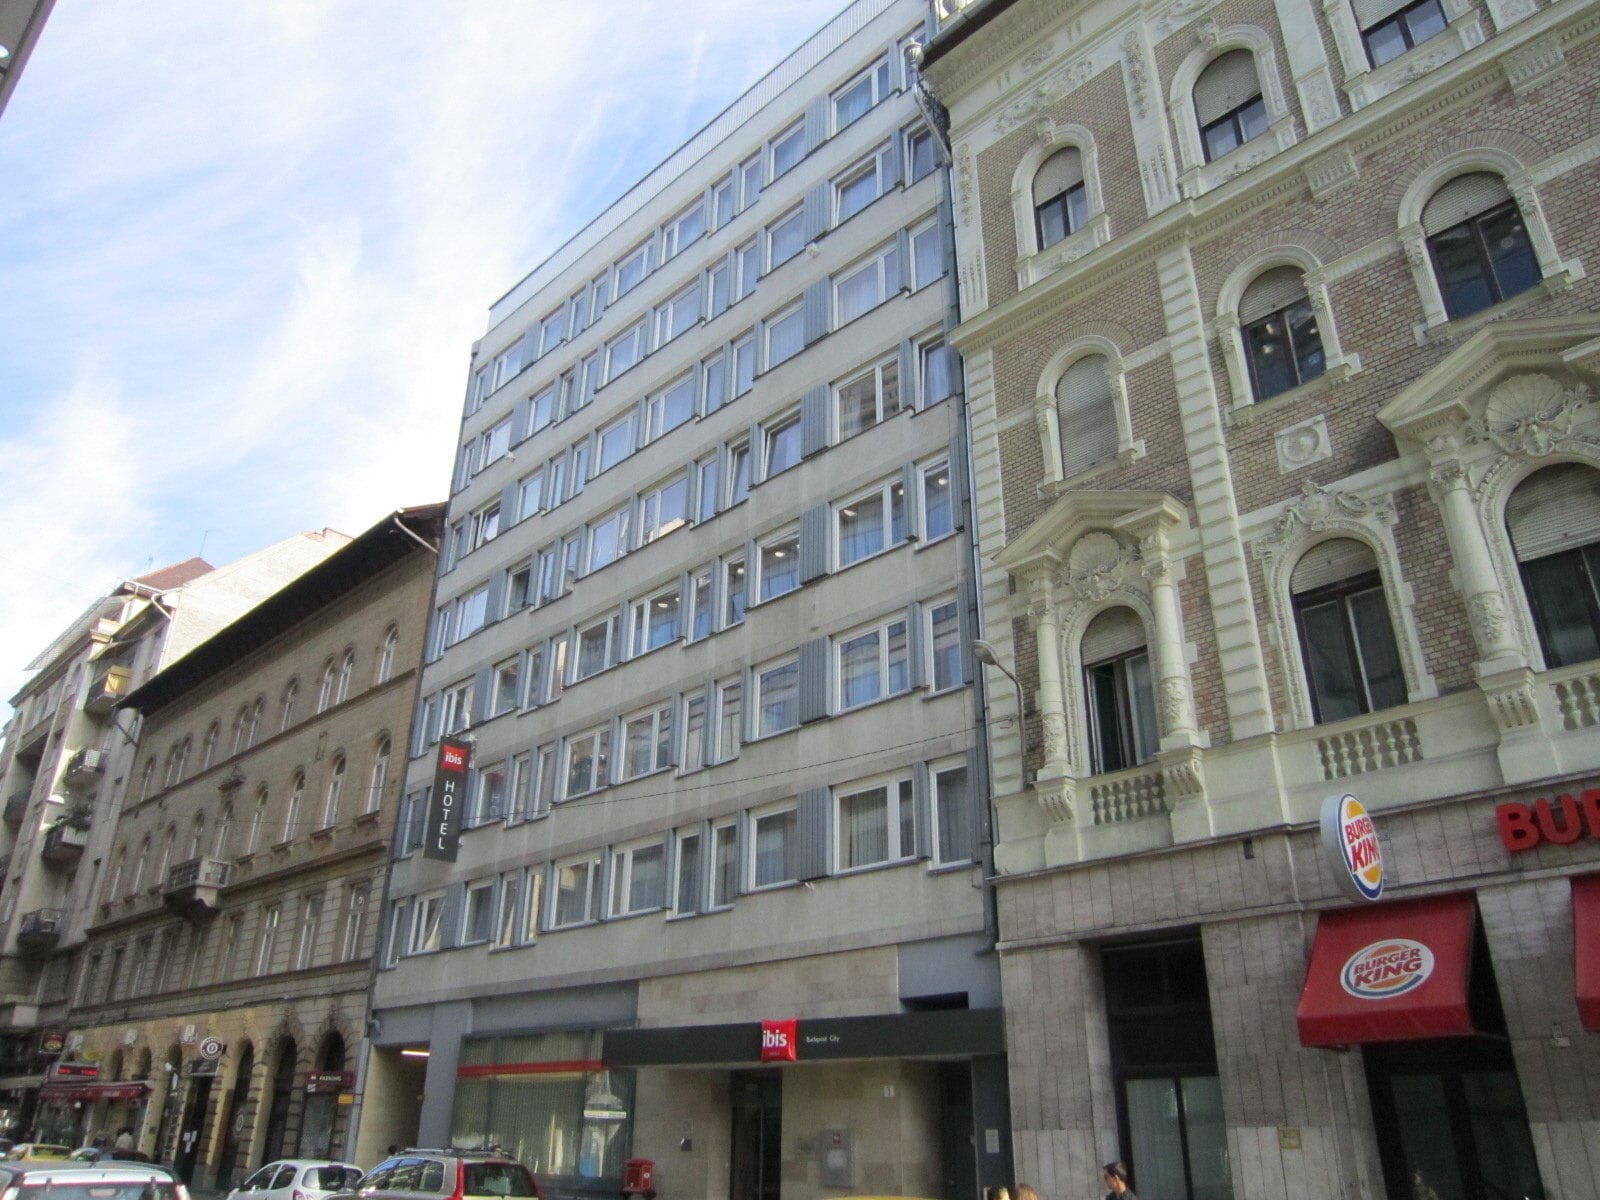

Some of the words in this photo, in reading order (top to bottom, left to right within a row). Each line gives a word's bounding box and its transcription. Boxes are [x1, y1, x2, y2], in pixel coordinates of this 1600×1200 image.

[445, 752, 462, 764] ibis
[438, 780, 454, 849] HOTEL
[1353, 957, 1422, 988] KING
[1354, 948, 1421, 976] BURGER
[763, 1030, 787, 1047] ibis
